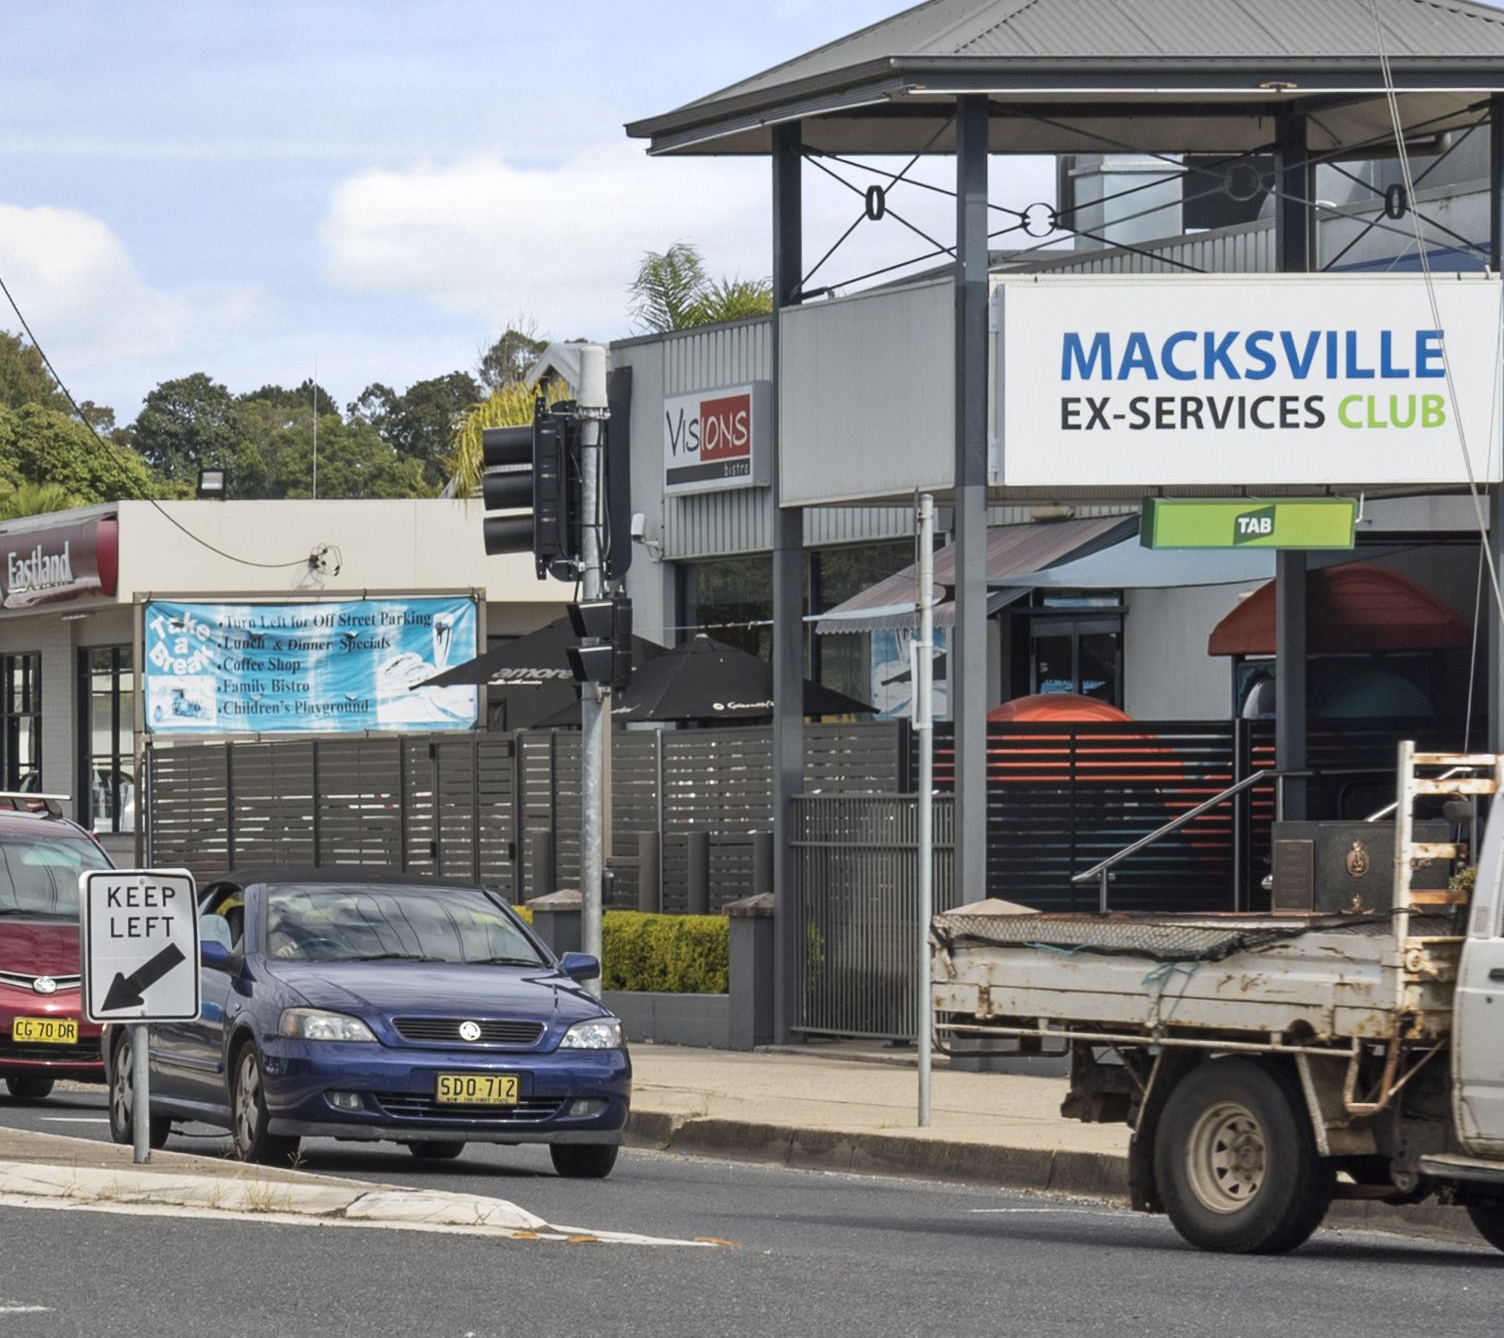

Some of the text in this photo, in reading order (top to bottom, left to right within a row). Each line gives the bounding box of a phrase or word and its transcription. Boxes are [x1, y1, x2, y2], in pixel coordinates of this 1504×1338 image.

[1061, 330, 1446, 381] MACKSVILLE
[1061, 394, 1446, 430] EX-SERVICES CLUB
[724, 463, 748, 477] bistro
[1237, 517, 1272, 534] TAB
[7, 541, 73, 590] Eastland
[149, 611, 211, 641] Take
[225, 611, 432, 629] Turn Left for Off Street Parking
[174, 637, 188, 654] a
[224, 636, 391, 653] Lunch & Dinner Specials
[149, 641, 214, 675] Break
[223, 657, 301, 674] Coffee Shop
[492, 668, 573, 679] amore
[224, 679, 310, 694] Family Bistro
[295, 700, 369, 717] Playground
[108, 886, 175, 908] KEEP
[111, 917, 174, 938] LEFT
